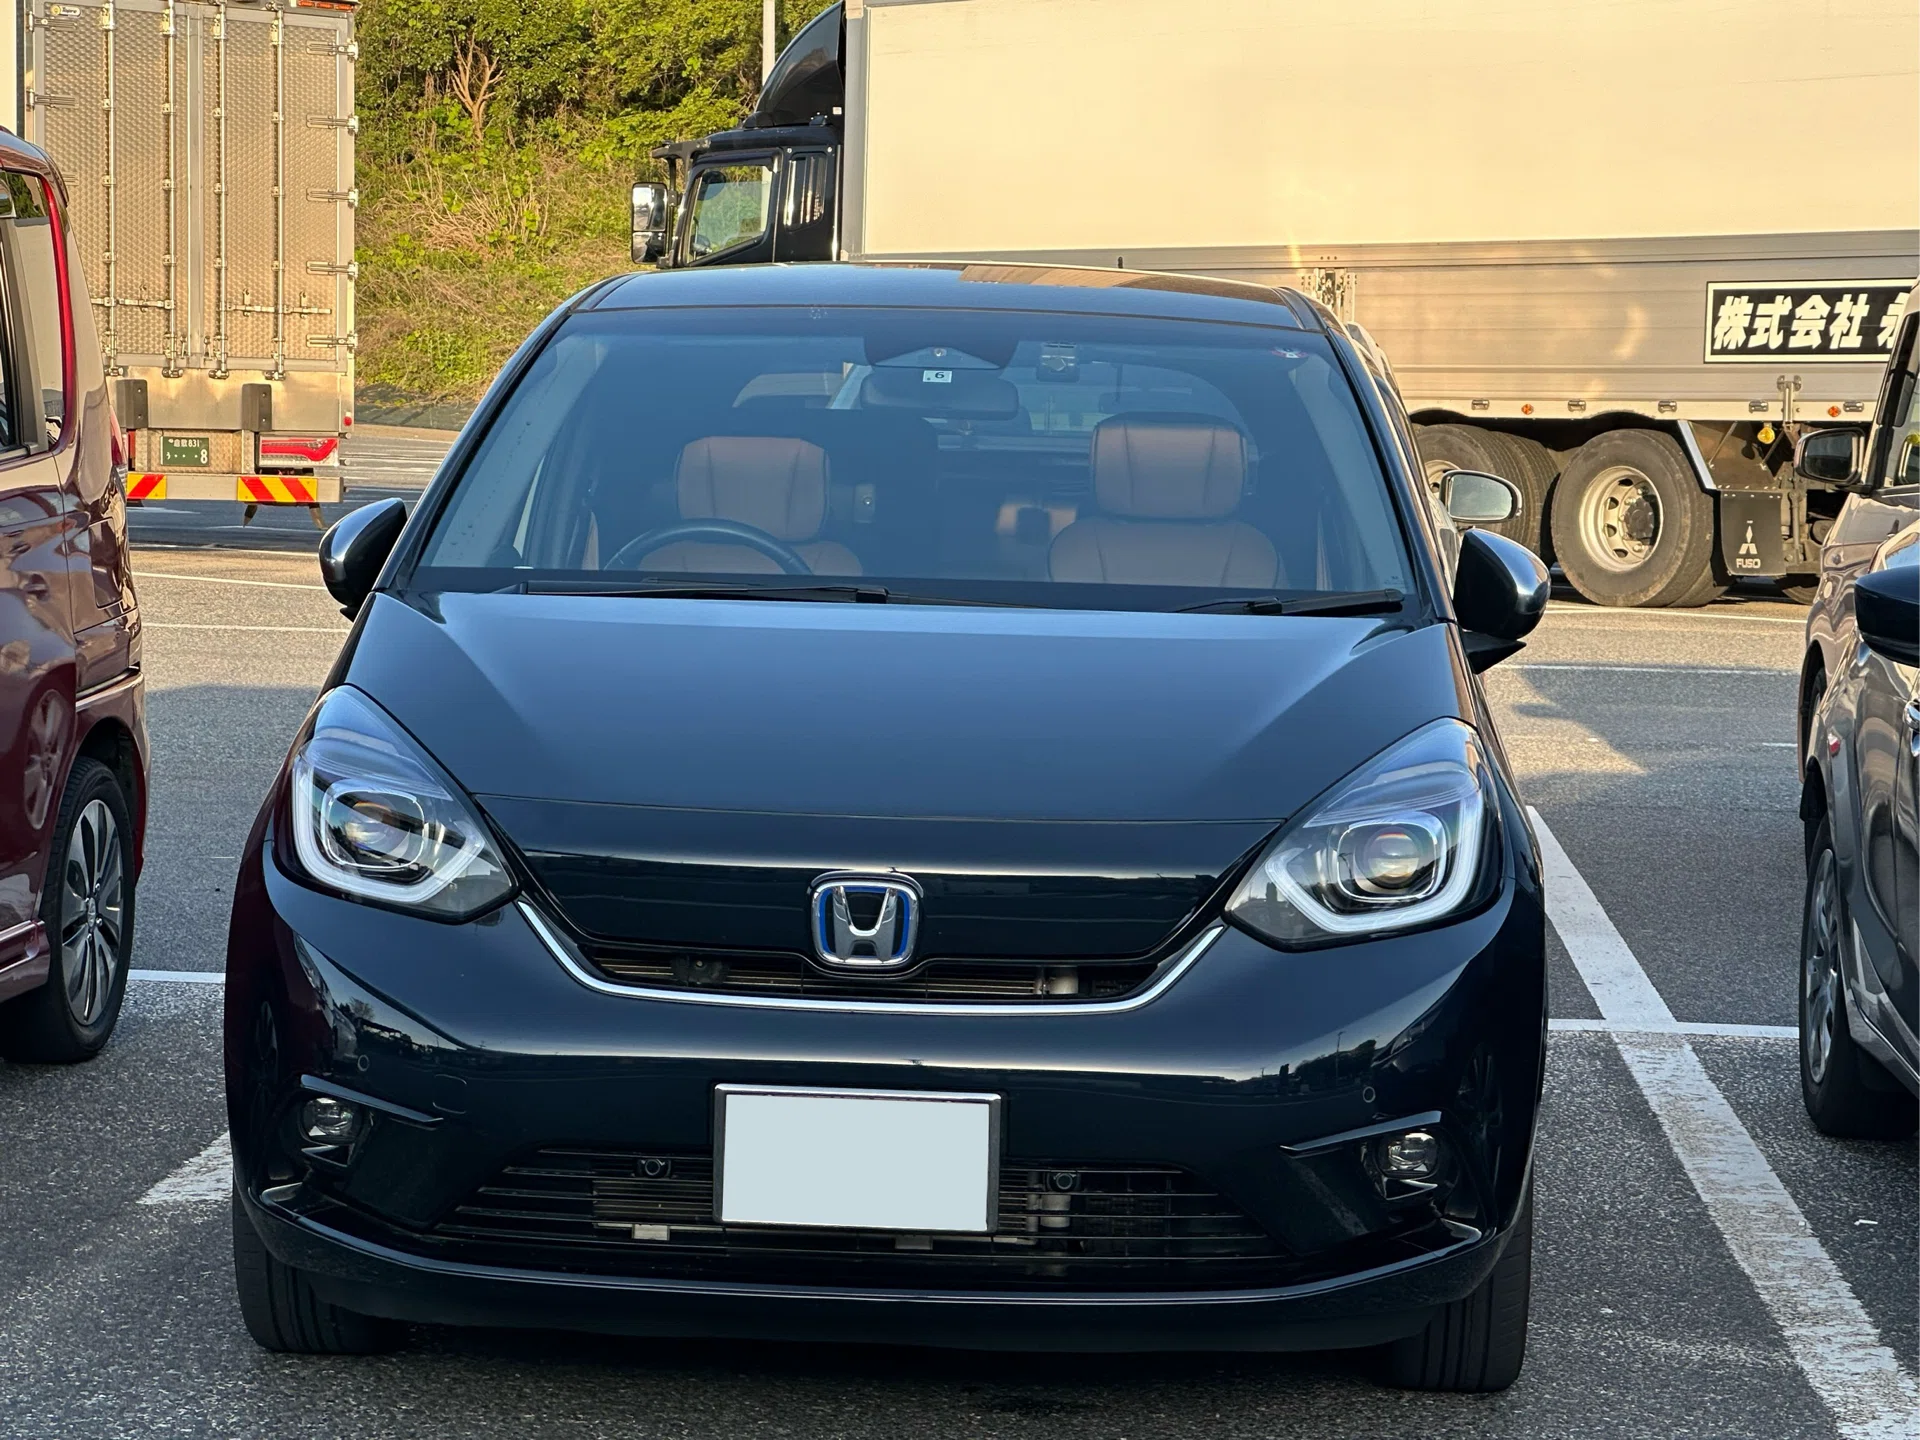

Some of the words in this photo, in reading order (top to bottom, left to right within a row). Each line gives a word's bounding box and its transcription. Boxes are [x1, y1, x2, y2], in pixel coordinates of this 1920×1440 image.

[1713, 293, 1870, 350] 株式会社
[1735, 558, 1761, 569] FUSO
